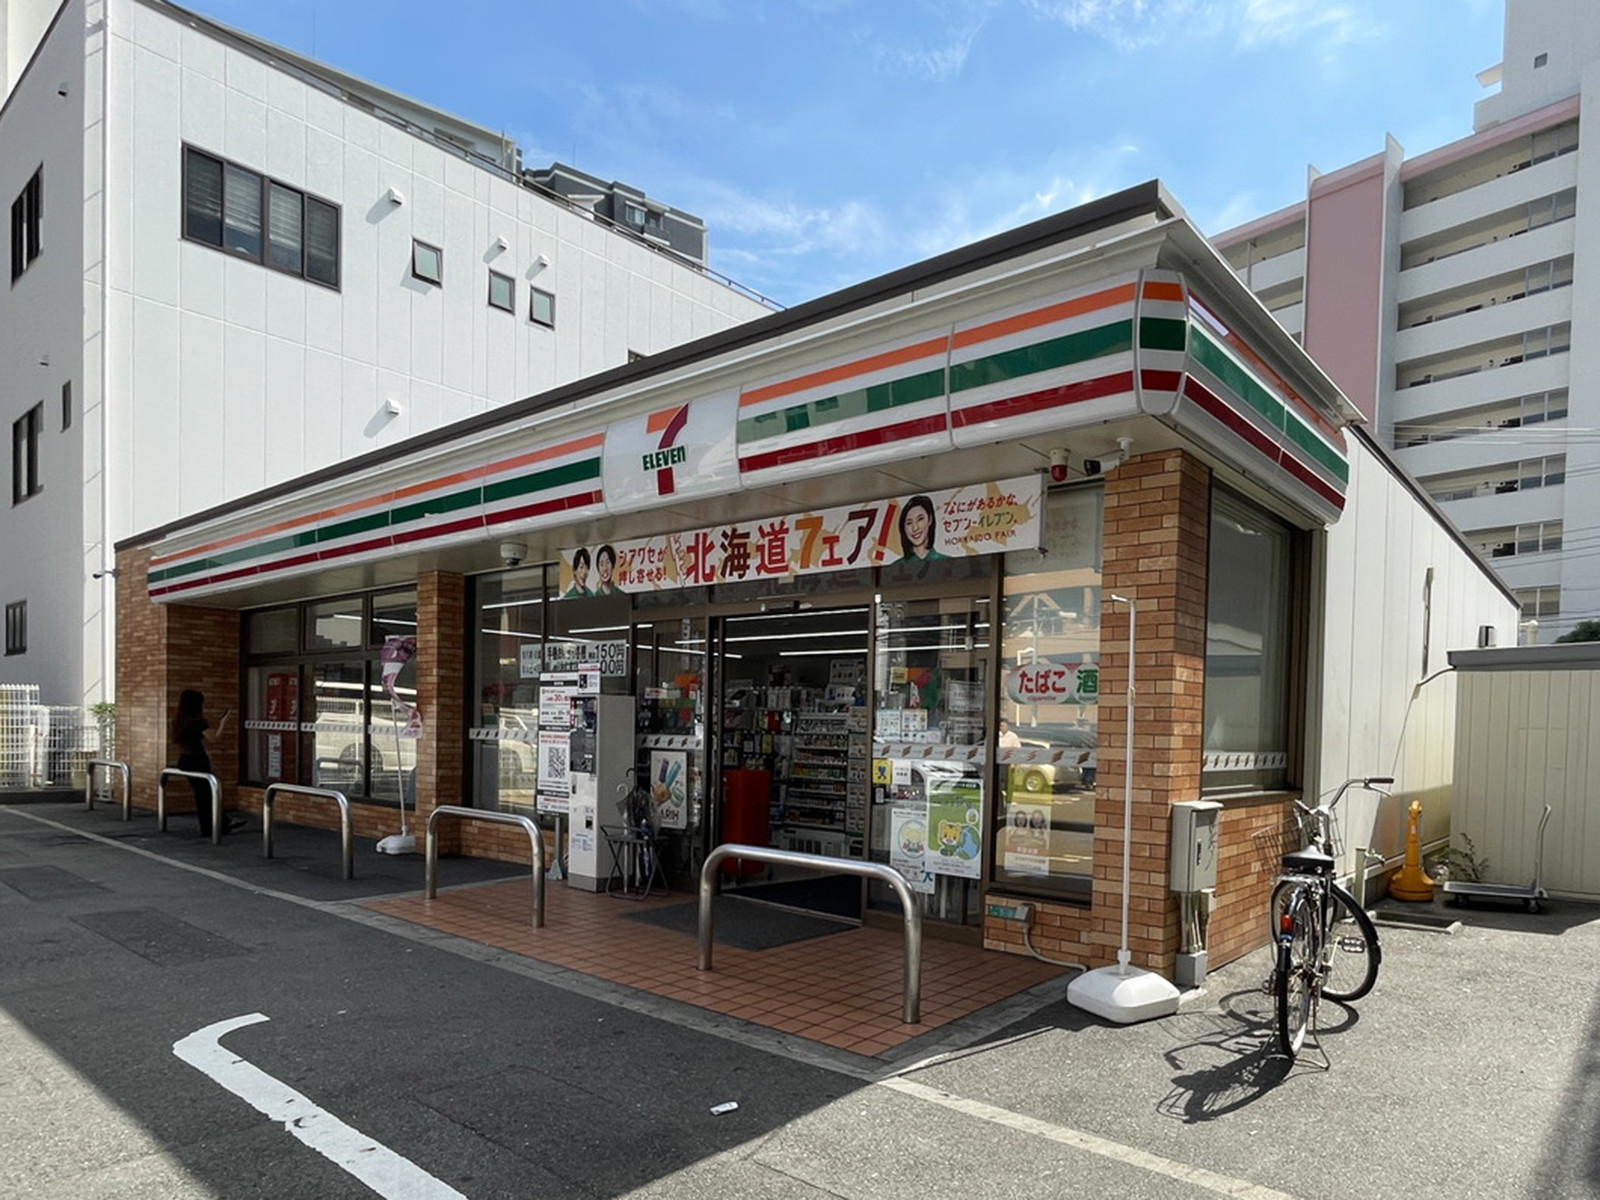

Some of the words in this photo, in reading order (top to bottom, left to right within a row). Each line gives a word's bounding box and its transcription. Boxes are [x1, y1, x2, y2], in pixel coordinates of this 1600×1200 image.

[646, 403, 689, 496] 7
[945, 532, 992, 546] HOKKAIDO
[995, 529, 1016, 539] FAIR
[619, 545, 668, 568] シアワセが
[1018, 669, 1066, 694] たばこ
[1076, 669, 1098, 694] 酒
